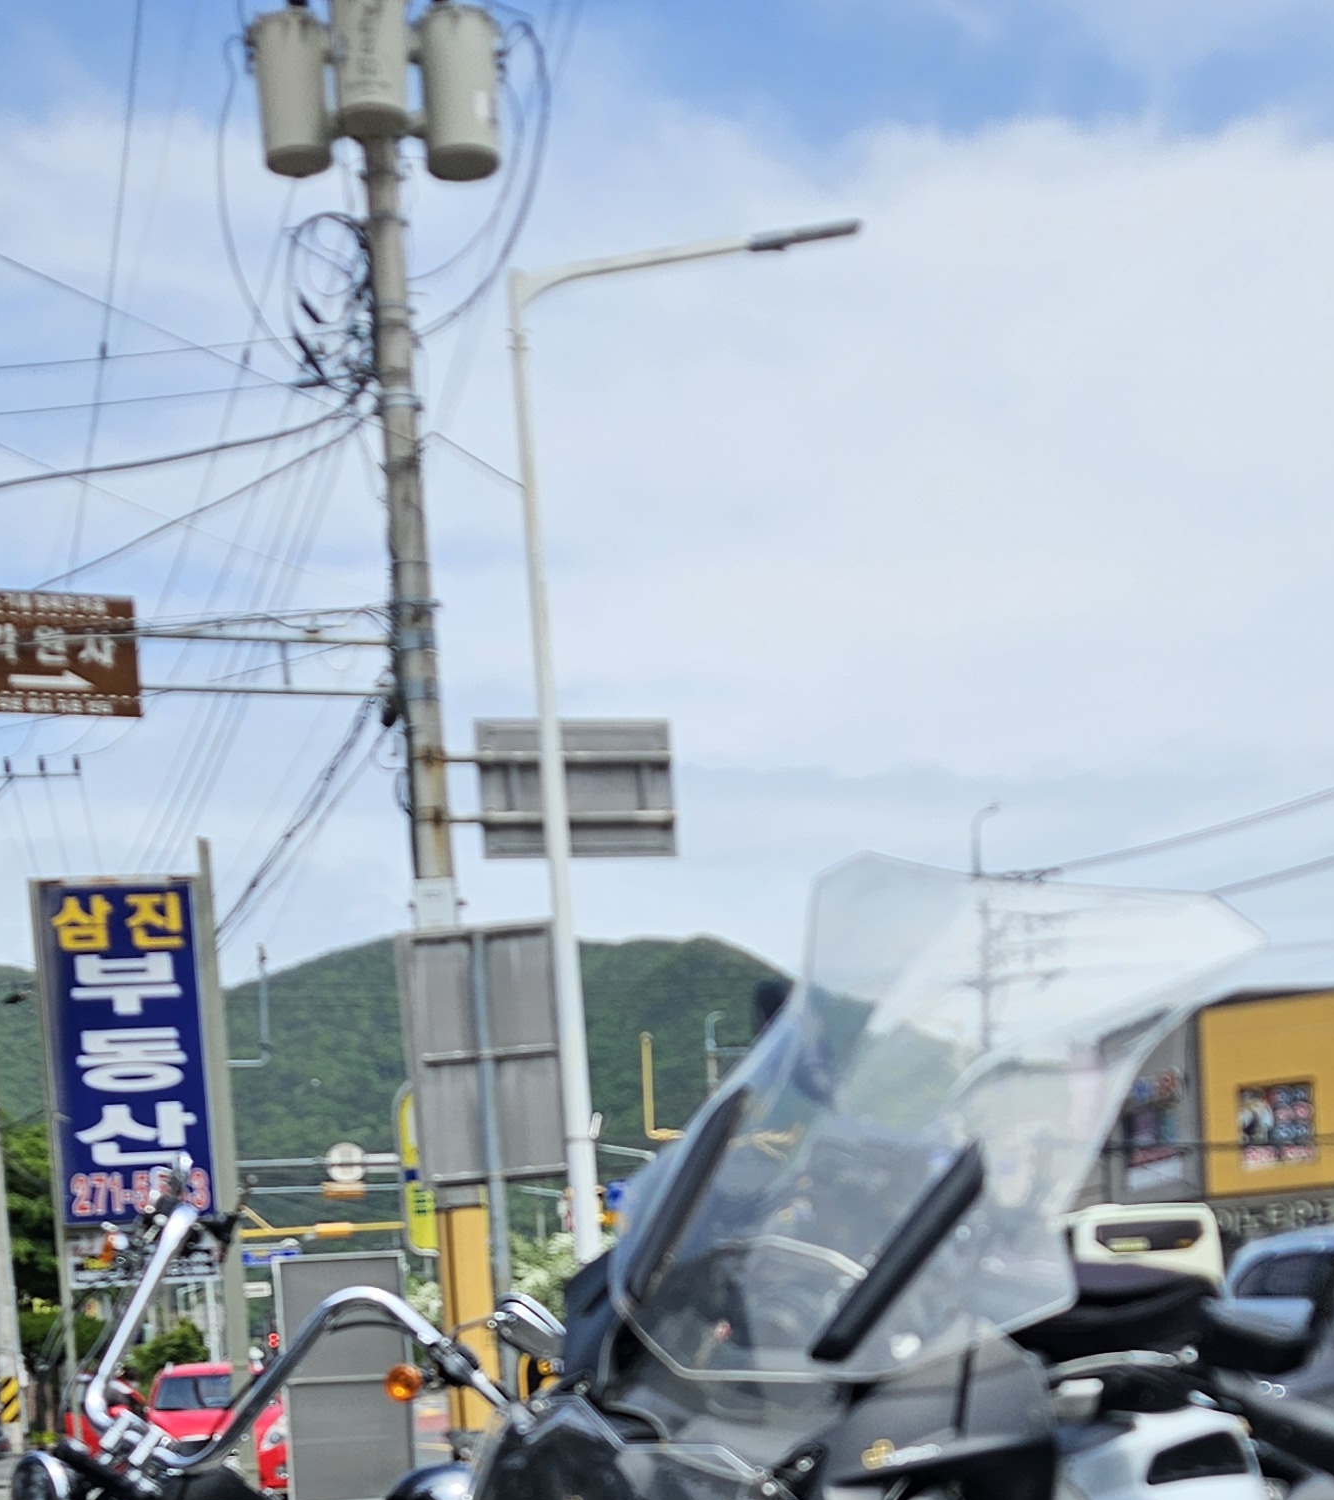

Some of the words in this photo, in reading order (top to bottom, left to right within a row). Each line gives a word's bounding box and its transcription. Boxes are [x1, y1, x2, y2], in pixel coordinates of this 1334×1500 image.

[50, 891, 186, 952] 삼진
[70, 951, 198, 1168] 부동산
[70, 1168, 211, 1217] 271-53
